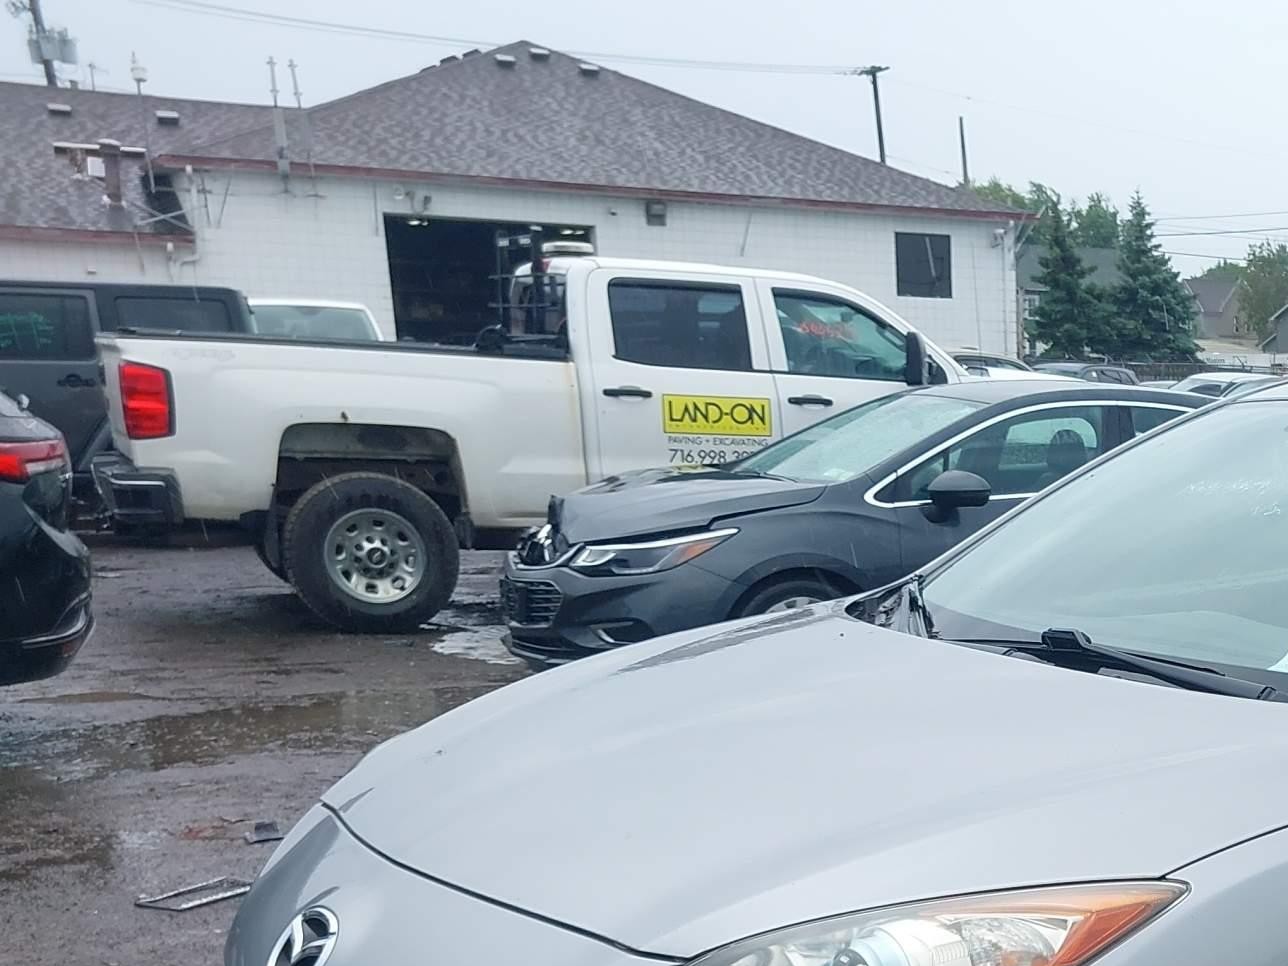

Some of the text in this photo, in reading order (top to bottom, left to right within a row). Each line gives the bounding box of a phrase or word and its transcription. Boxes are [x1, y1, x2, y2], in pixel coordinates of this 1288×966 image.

[668, 400, 766, 425] LAND-ON
[668, 436, 769, 447] PAVING EXCAVATING
